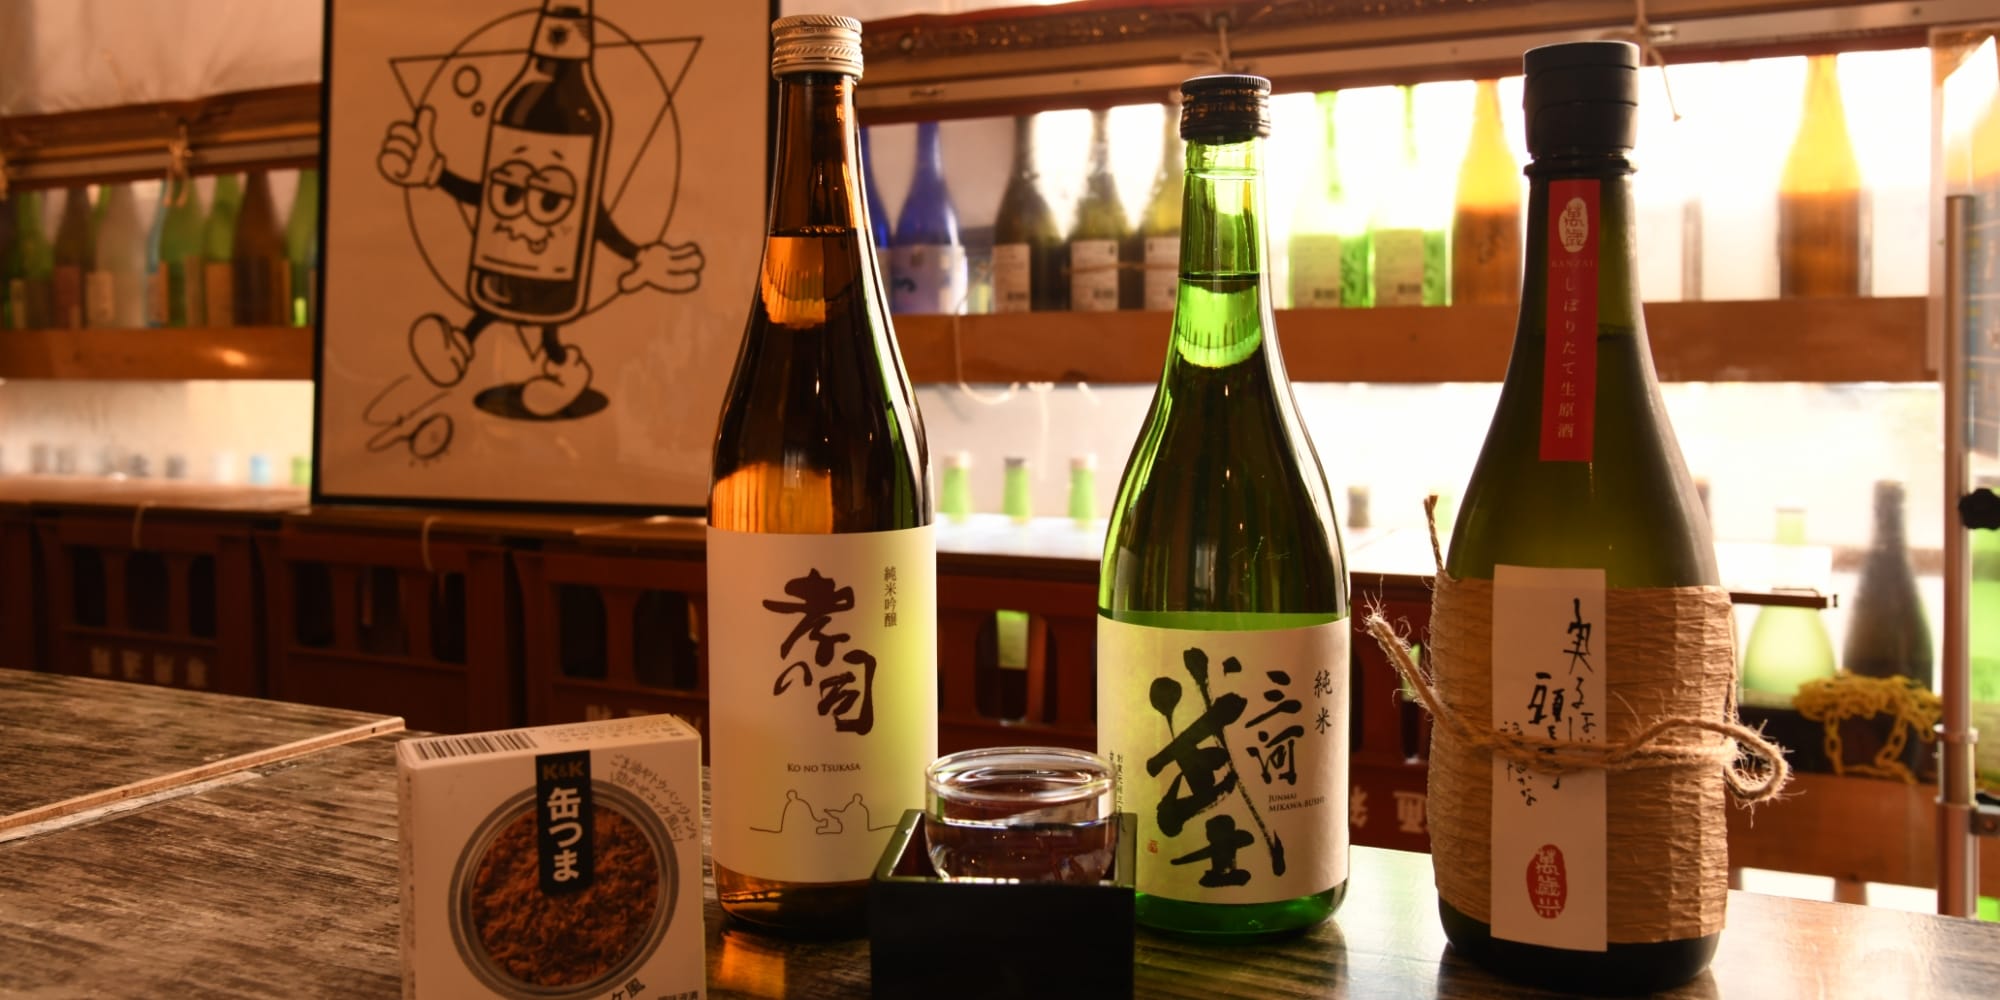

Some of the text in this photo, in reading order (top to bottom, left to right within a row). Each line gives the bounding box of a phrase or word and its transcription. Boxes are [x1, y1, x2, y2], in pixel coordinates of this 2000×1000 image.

[1556, 275, 1581, 439] しぼりたて生原酒
[883, 565, 897, 628] 純米吟醸
[762, 567, 877, 735] 孝の司
[1244, 670, 1305, 786] 三河
[1312, 669, 1334, 735] 純米
[821, 762, 861, 773] TSUKASA
[1146, 647, 1287, 888] 武士
[1268, 791, 1298, 803] JUNMAI
[547, 787, 583, 882] 缶つま
